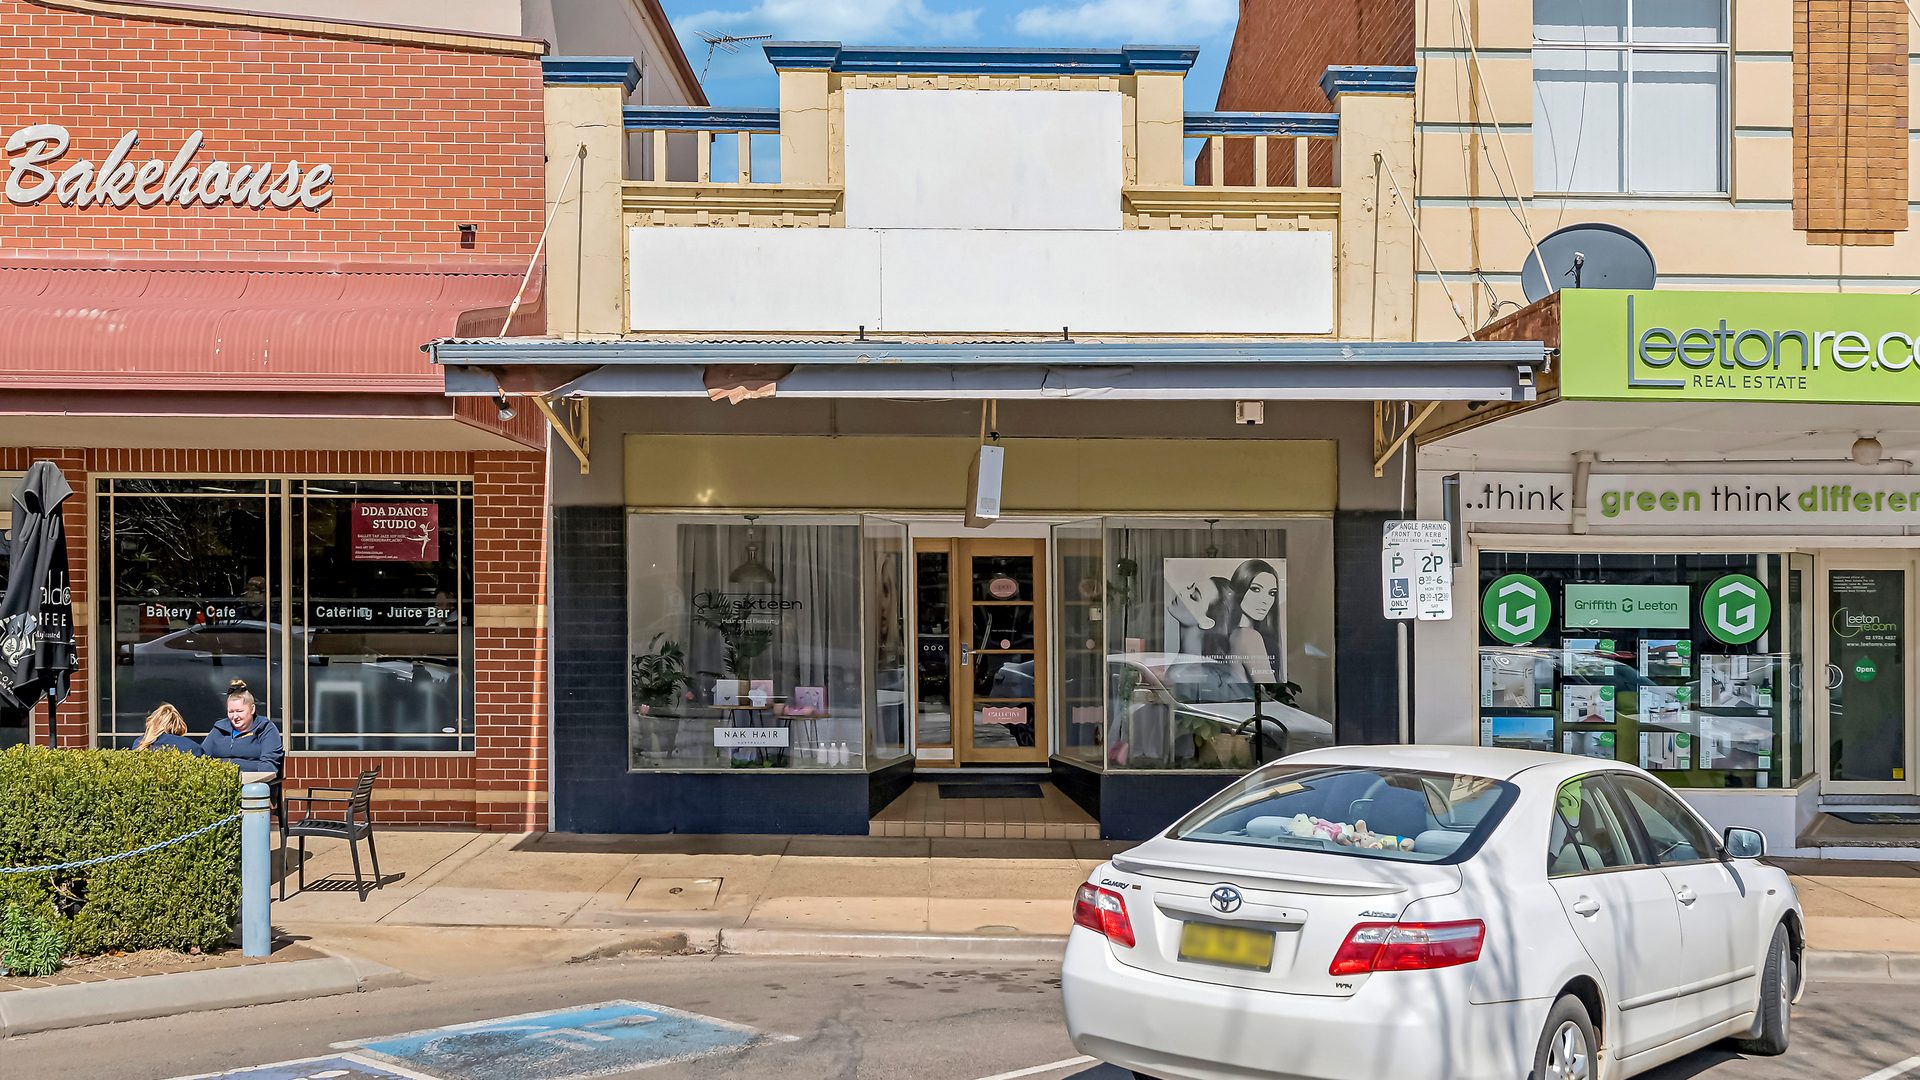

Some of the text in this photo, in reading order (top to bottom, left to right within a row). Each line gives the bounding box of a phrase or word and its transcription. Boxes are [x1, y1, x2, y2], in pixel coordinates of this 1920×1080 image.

[5, 124, 334, 210] Bakehouse
[1627, 294, 1920, 390] Leetonre.c
[1692, 375, 1807, 390] REAL ESTATE
[1600, 490, 1701, 518] green
[1711, 485, 1791, 512] think
[361, 506, 428, 517] DDA DANCE
[372, 519, 417, 529] STUDIO
[1421, 523, 1447, 531] PARKING
[1391, 556, 1404, 573] P
[1421, 556, 1443, 573] 2P
[732, 598, 803, 610] sixteen
[1574, 599, 1617, 610] Griffith
[1637, 600, 1678, 611] Leeton
[146, 606, 192, 620] Bakery
[205, 605, 236, 618] Cafe
[316, 606, 373, 620] Catering
[387, 606, 423, 618] Juice
[427, 607, 450, 618] Bar
[1846, 610, 1880, 628] Leeton
[1860, 623, 1897, 632] re.com
[724, 730, 779, 739] NAK HAIR
[1100, 878, 1130, 889] CAMRY
